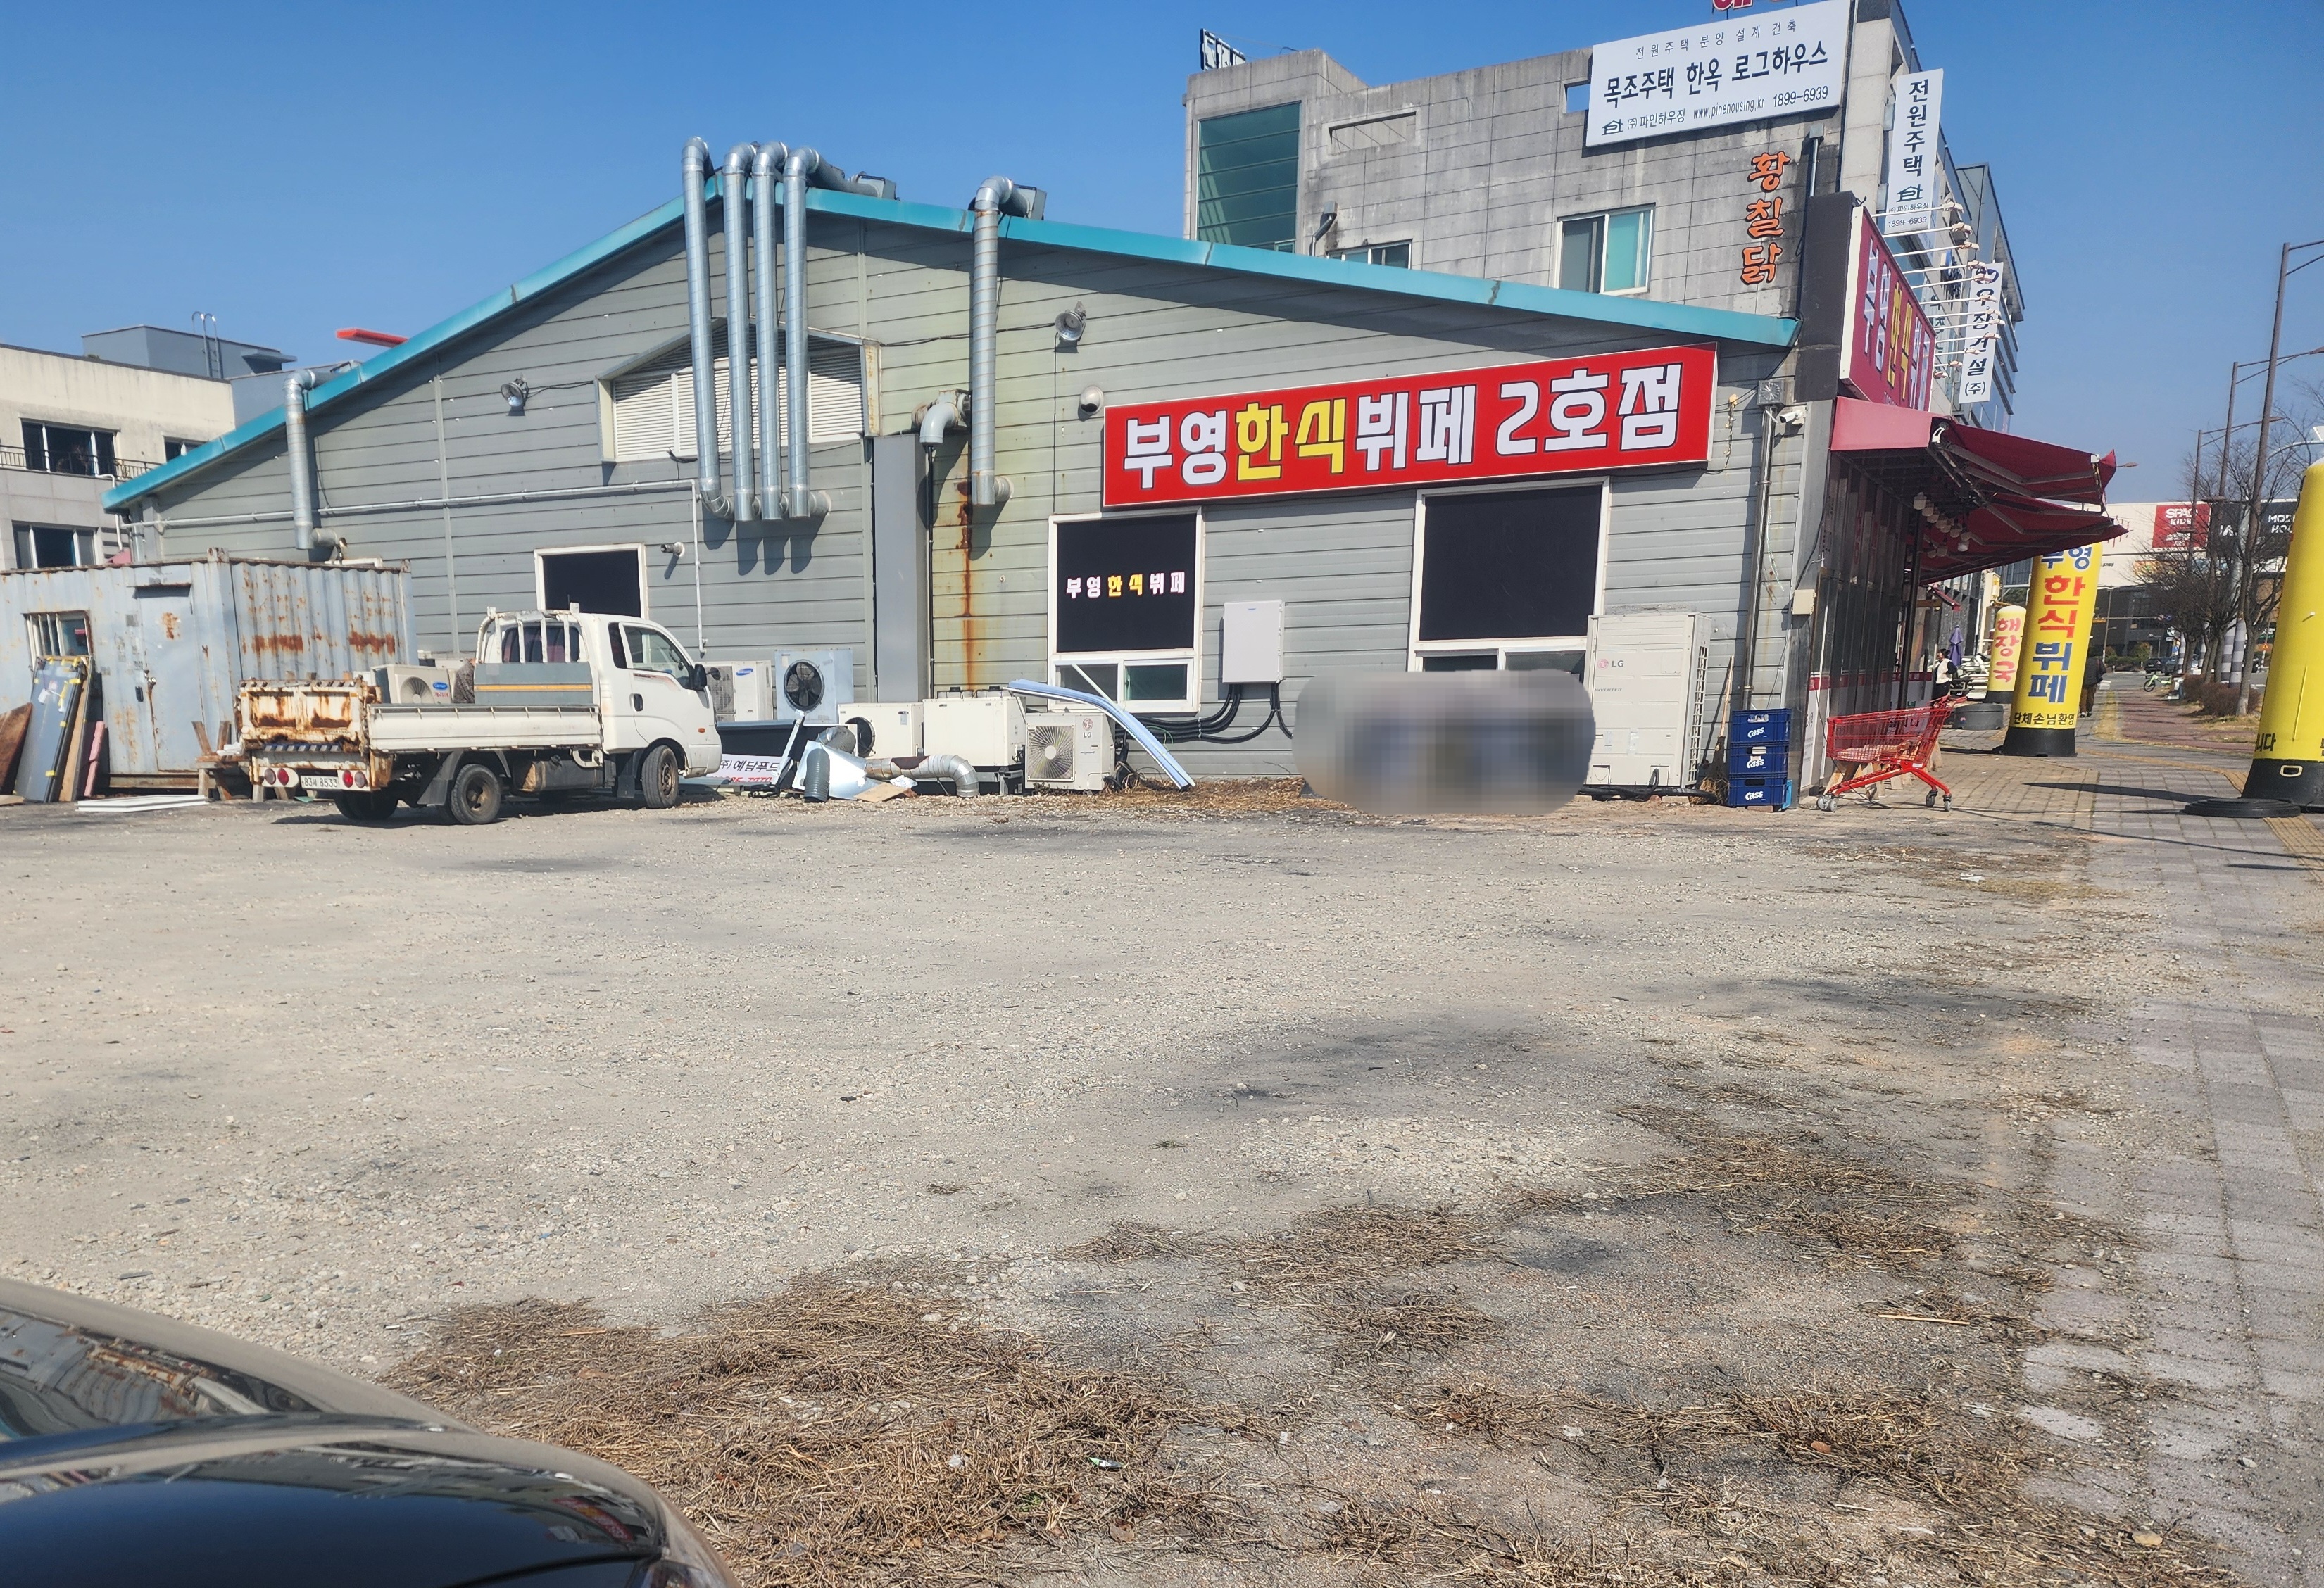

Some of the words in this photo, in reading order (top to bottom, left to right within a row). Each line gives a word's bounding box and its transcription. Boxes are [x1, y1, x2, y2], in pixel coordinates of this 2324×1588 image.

[1635, 38, 1689, 60] 전원주택
[1700, 32, 1724, 49] 분양
[1735, 25, 1760, 42] 설계
[1772, 18, 1797, 36] 건축
[1604, 67, 1675, 108] 목조주택
[1686, 58, 1722, 96] 한옥
[1731, 40, 1828, 82] 로그하우스
[1639, 108, 1686, 129] 파인하우징
[1693, 96, 1765, 120] www.pinehousing.kr
[1773, 85, 1829, 108] 1899-6939
[1903, 78, 1929, 177] 전원주택
[1740, 150, 1791, 286] 황칠닭
[1888, 216, 1927, 227] 1899-6939
[1124, 384, 1478, 490] 부영한식뷔페
[1496, 363, 1684, 455] 2호점
[1067, 572, 1186, 599] 부영한식뷔페
[1993, 617, 2021, 683] 해장국
[1747, 727, 1765, 738] Cass
[320, 778, 338, 788] 8533
[1745, 790, 1764, 801] Cass
